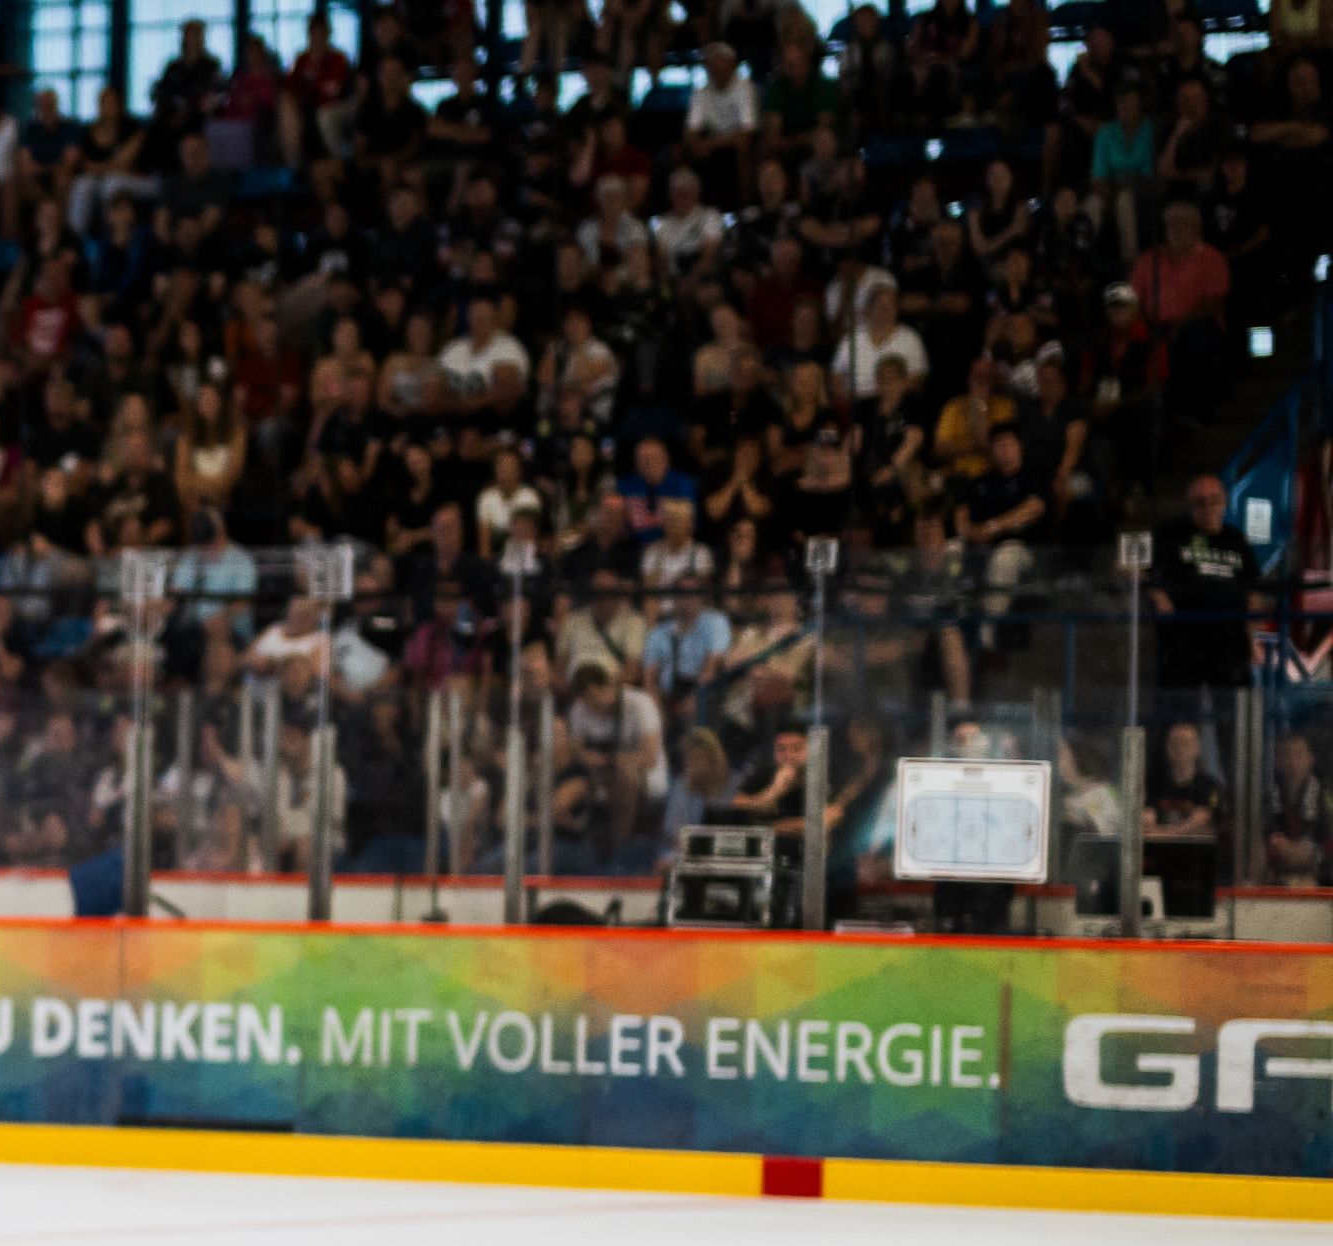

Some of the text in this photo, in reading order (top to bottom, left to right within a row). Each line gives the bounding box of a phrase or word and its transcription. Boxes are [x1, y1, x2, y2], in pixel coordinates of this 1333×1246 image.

[34, 998, 302, 1065] DENKEN.
[322, 1006, 432, 1068] MIT
[447, 1010, 686, 1078] VOLLER
[707, 1017, 1001, 1089] ENERGIE.
